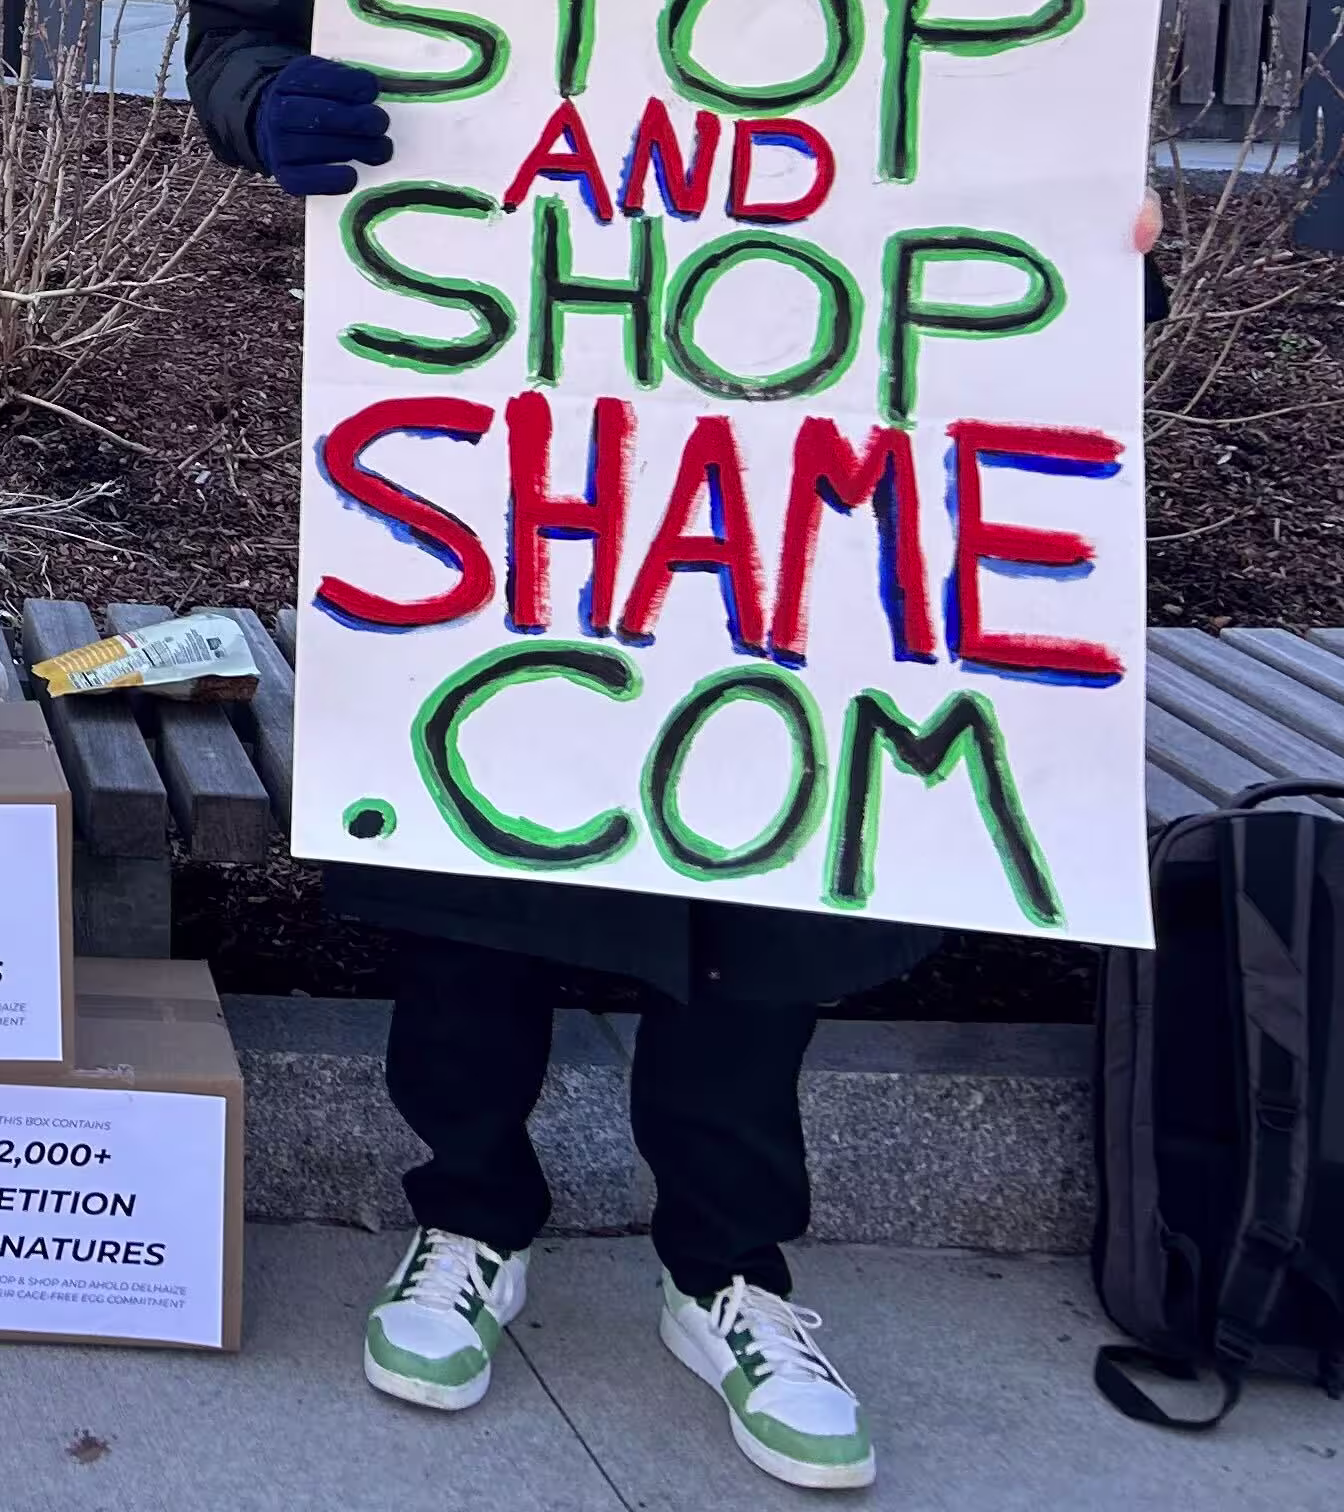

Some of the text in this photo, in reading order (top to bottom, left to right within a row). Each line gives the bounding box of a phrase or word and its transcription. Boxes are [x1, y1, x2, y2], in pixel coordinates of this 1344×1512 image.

[501, 97, 837, 225] AND
[336, 184, 1066, 430] SHOP
[314, 392, 1127, 687] SHAME
[342, 638, 1063, 928] .COM
[25, 1117, 50, 1127] BOX
[52, 1118, 111, 1130] CONTAINS
